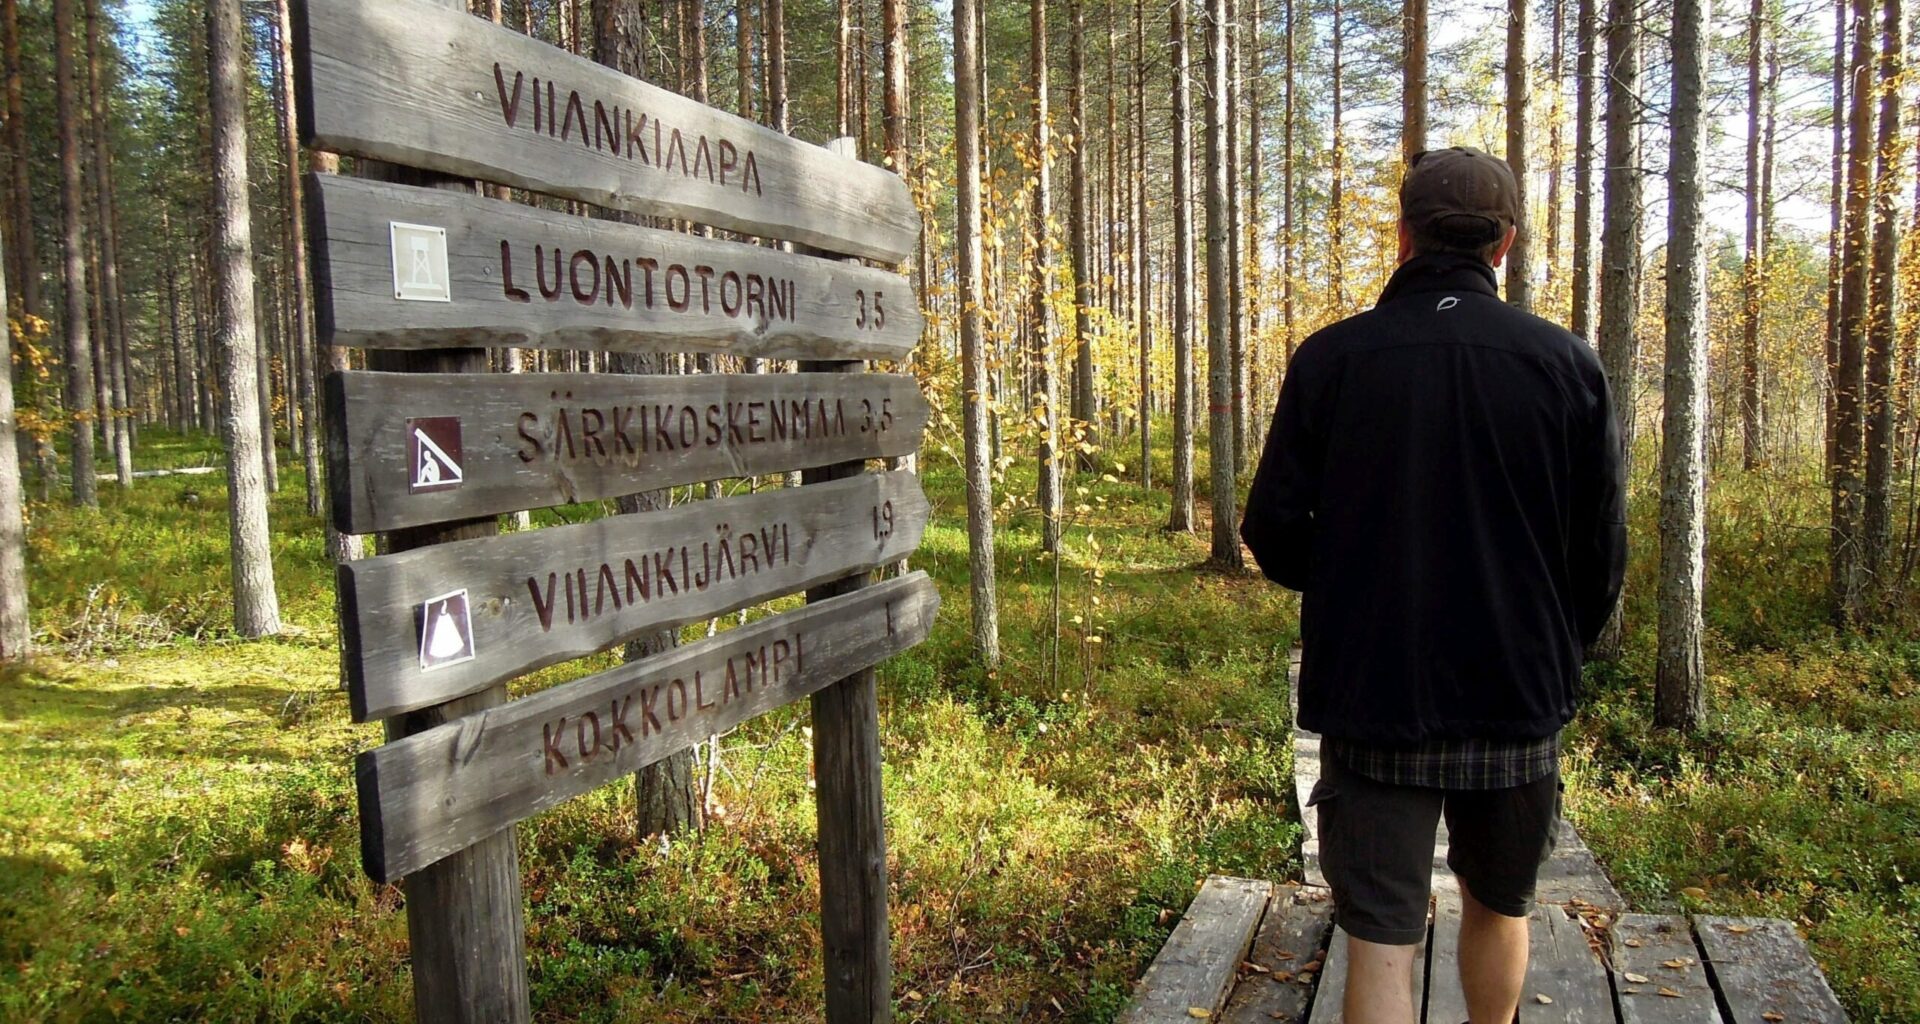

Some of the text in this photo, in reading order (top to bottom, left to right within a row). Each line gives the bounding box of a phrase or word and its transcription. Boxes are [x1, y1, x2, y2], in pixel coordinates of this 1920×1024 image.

[493, 62, 762, 197] VIIANKIAAPA
[500, 239, 795, 323] LUONTOTORNI
[516, 390, 845, 463] SÄRKIKOSKENMAA
[527, 523, 790, 632] VIIANKIJÄRVI
[543, 633, 802, 776] KOKKOLAMPI
